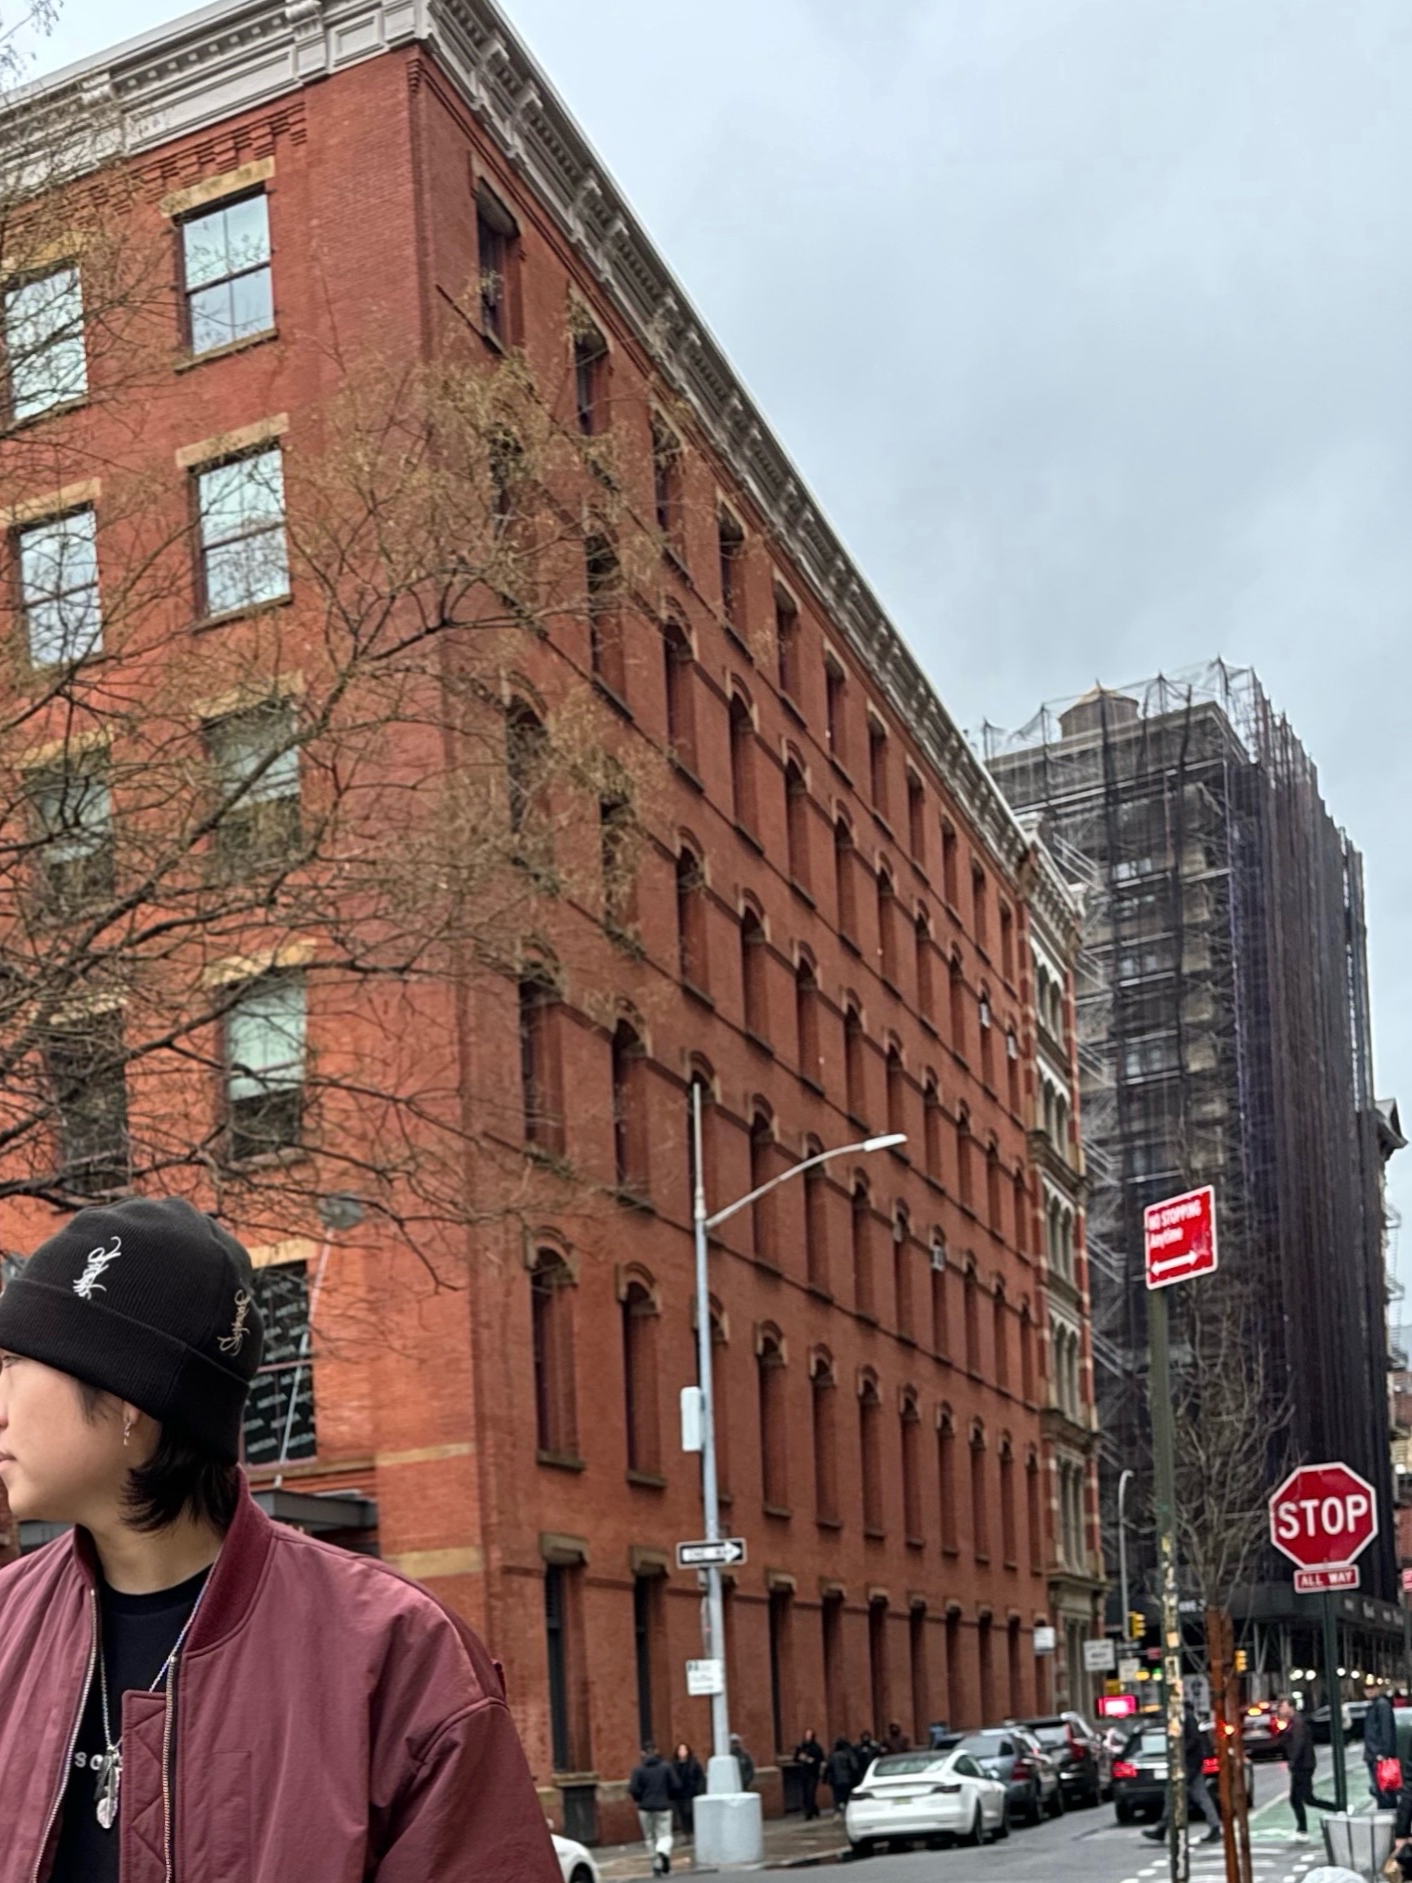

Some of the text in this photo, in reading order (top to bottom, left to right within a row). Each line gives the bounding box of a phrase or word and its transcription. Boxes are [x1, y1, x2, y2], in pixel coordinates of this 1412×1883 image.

[1278, 1494, 1368, 1540] STOP
[1300, 1572, 1353, 1588] ALL WAY
